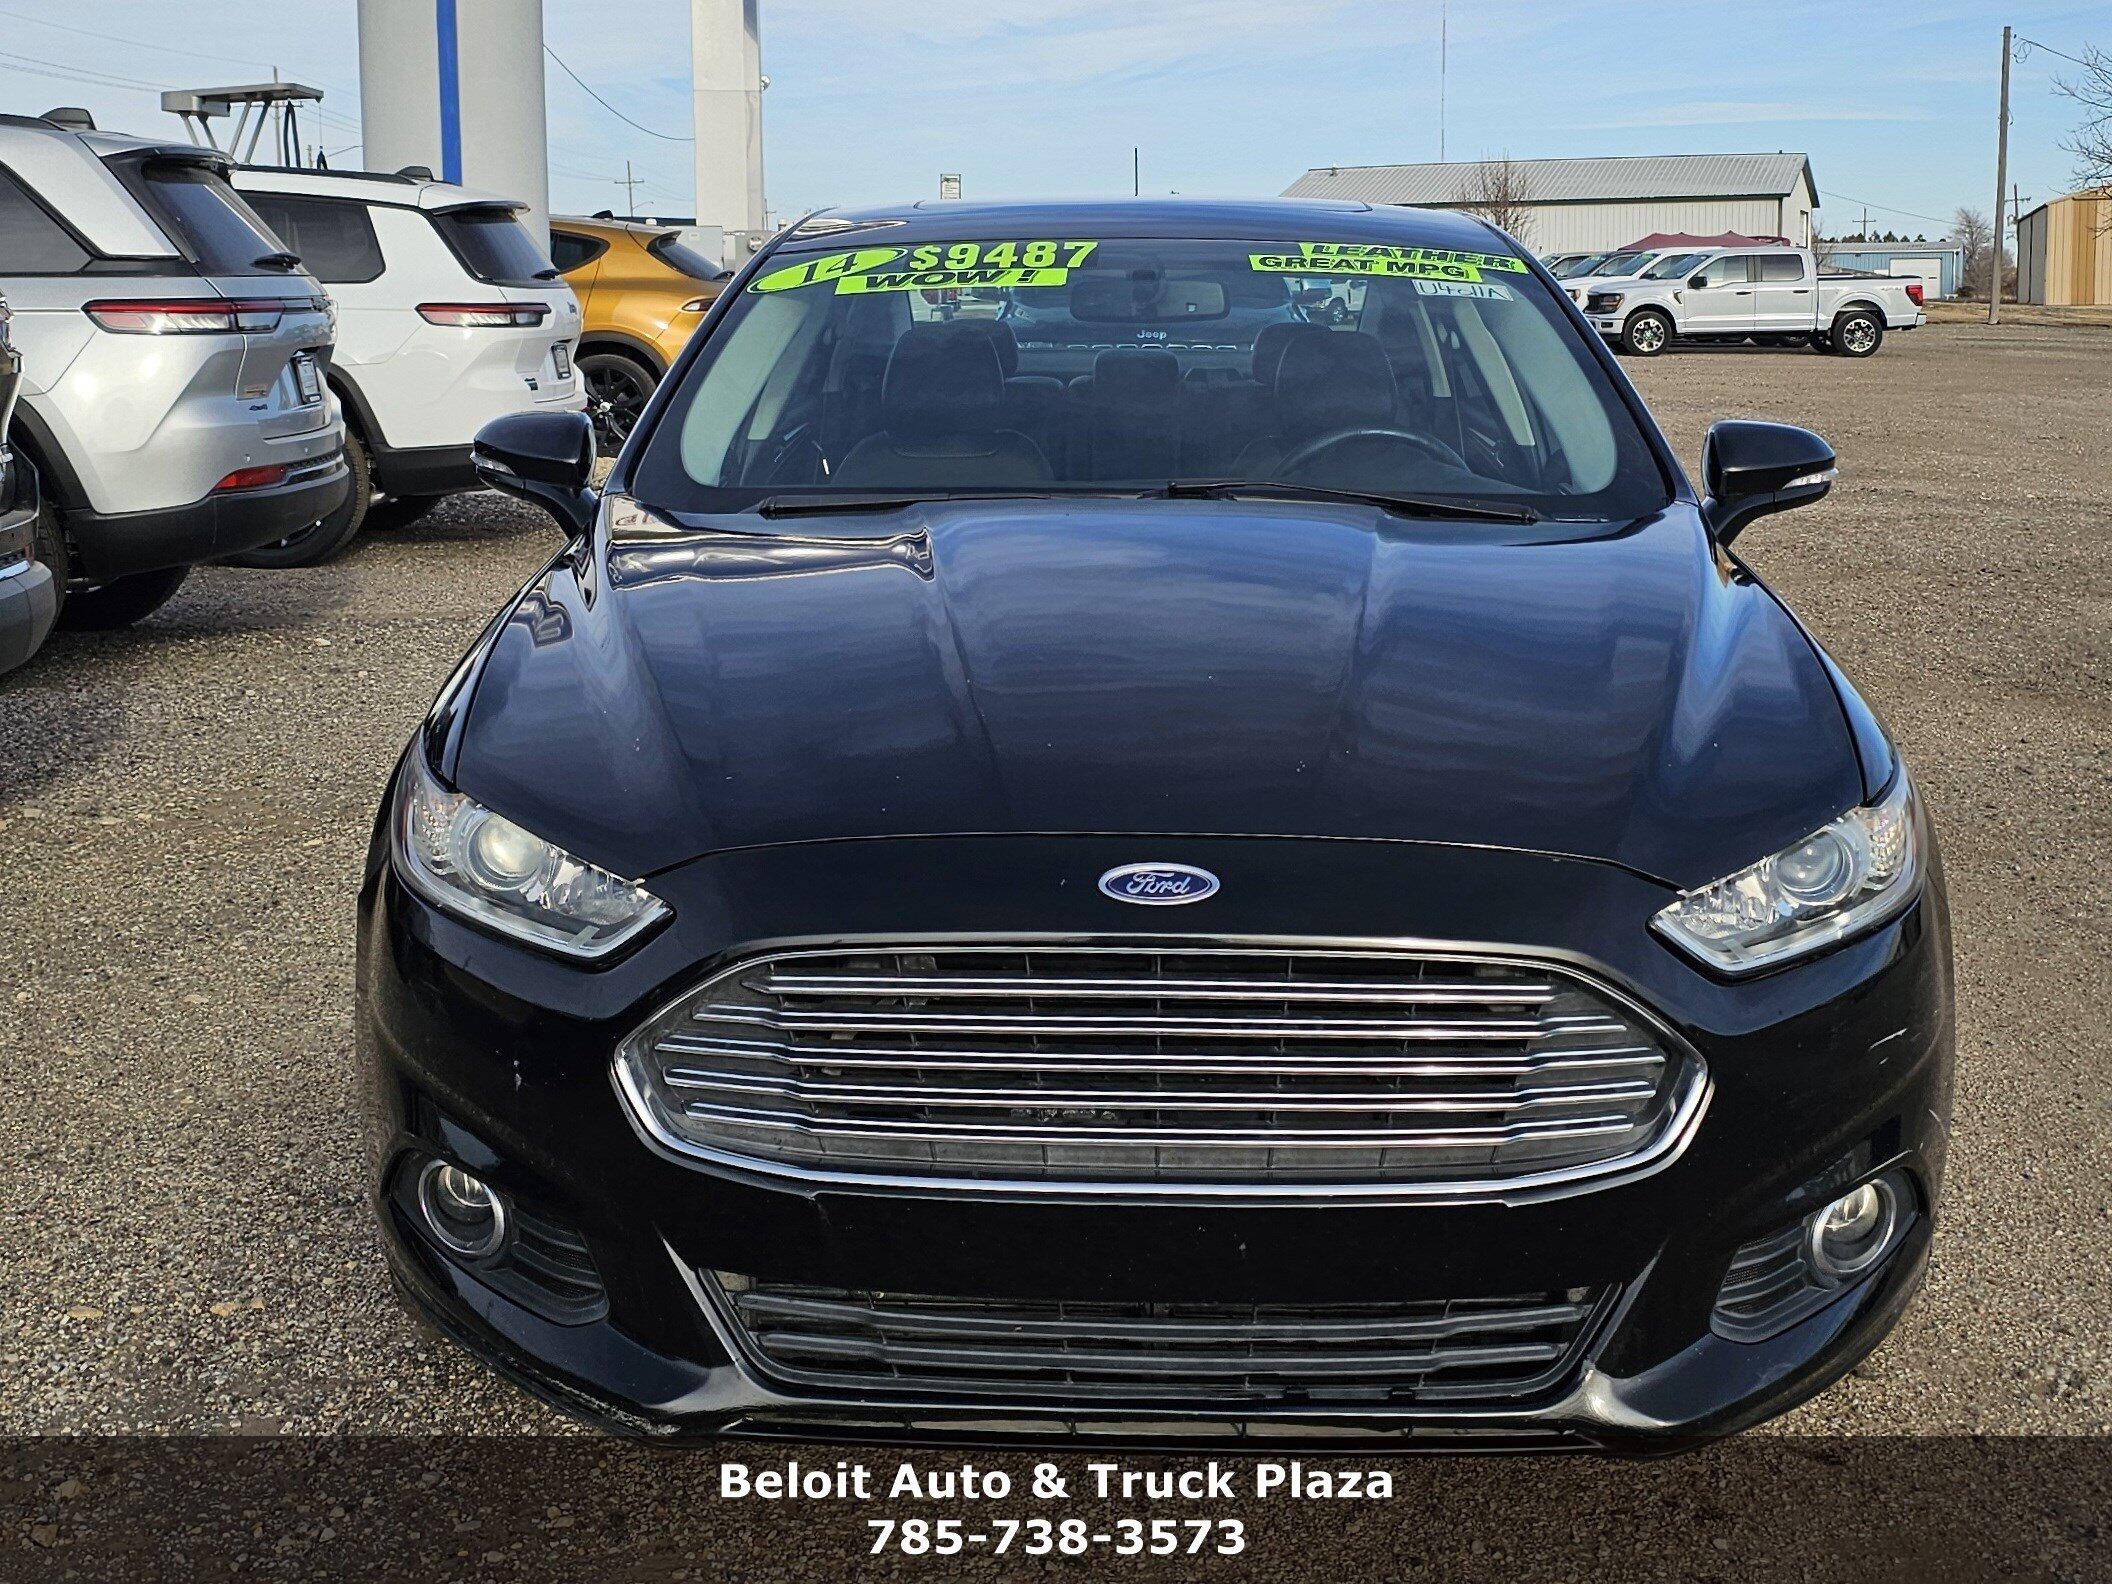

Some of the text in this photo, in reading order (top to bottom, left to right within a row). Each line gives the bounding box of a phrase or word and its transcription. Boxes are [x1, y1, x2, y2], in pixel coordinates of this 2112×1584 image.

[797, 241, 1099, 285] 14 $9487
[1258, 256, 1468, 278] GREAT MPG
[1310, 244, 1516, 270] LEATHER
[1136, 329, 1167, 340] Jeep
[1126, 871, 1191, 894] Ford
